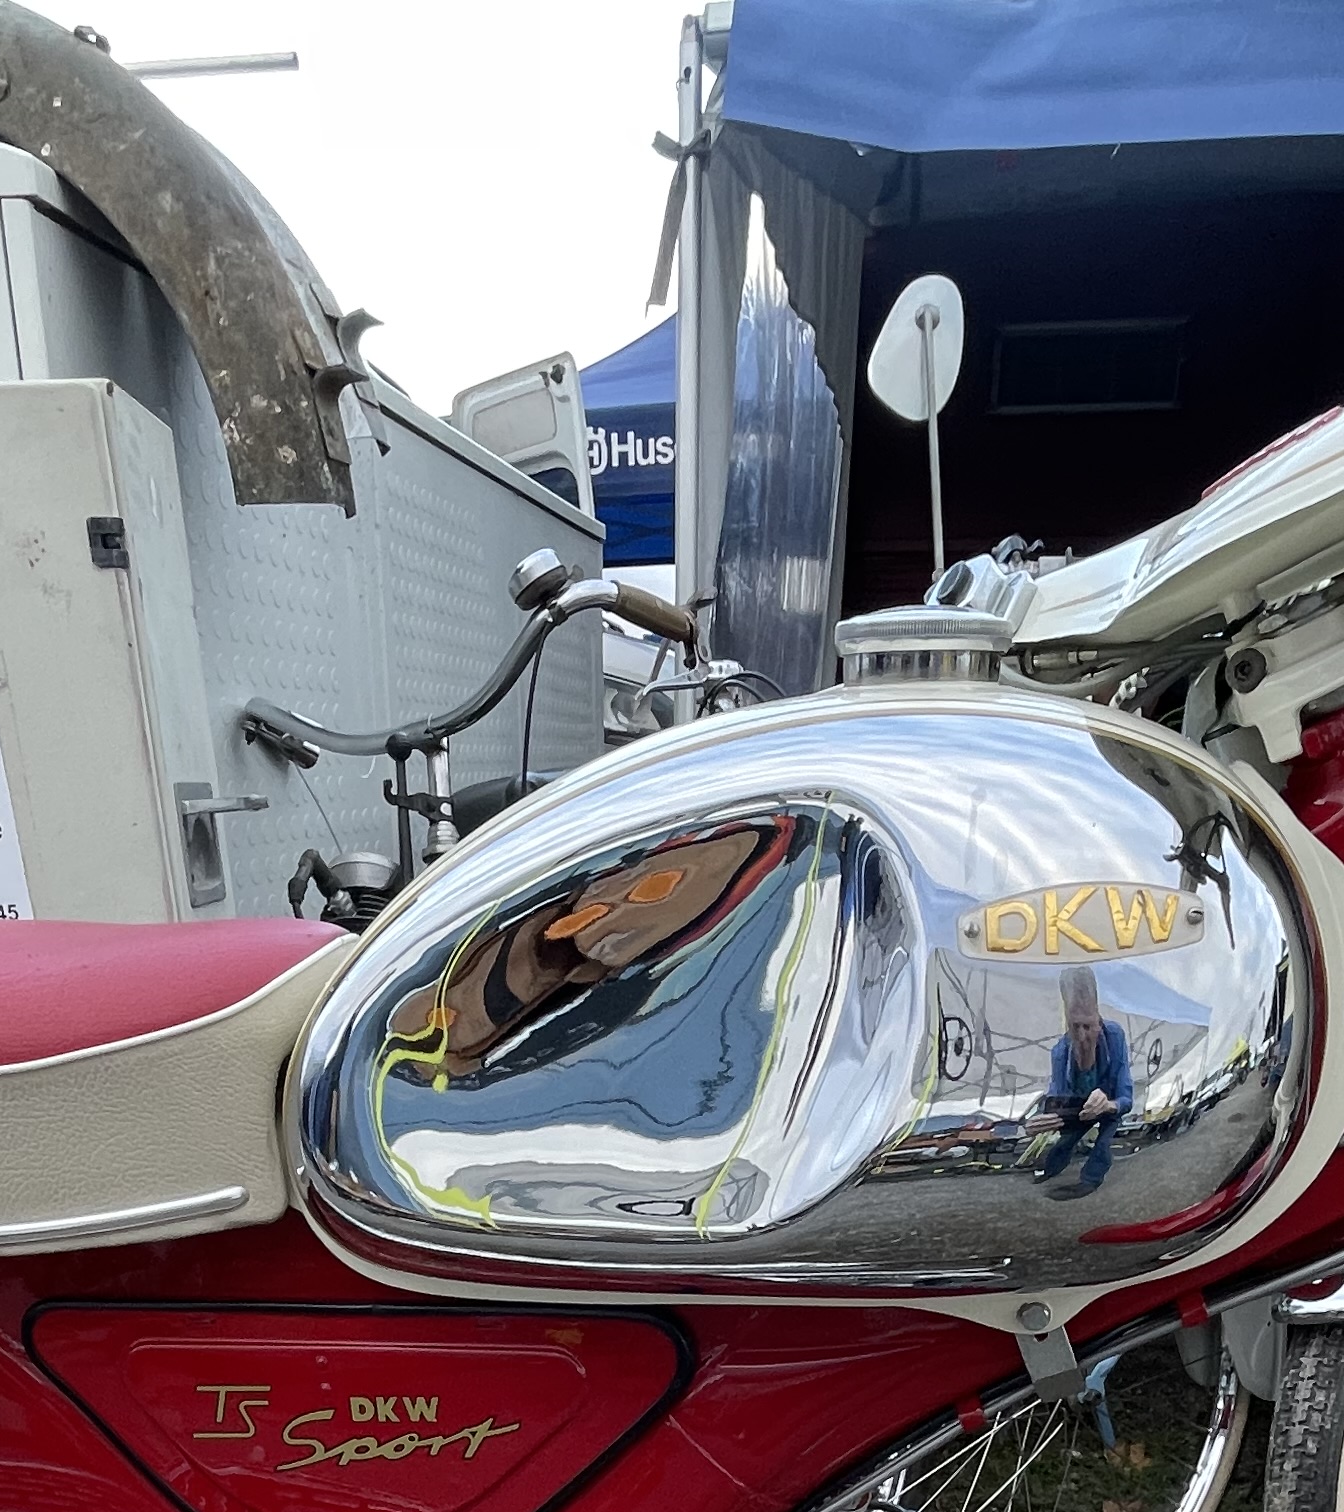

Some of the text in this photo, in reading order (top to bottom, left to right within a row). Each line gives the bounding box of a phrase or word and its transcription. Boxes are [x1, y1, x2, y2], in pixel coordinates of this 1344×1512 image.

[610, 430, 676, 468] Hus
[985, 886, 1180, 956] DKW
[193, 1385, 271, 1438] TS
[350, 1396, 439, 1423] DKW
[276, 1409, 520, 1471] Sport
